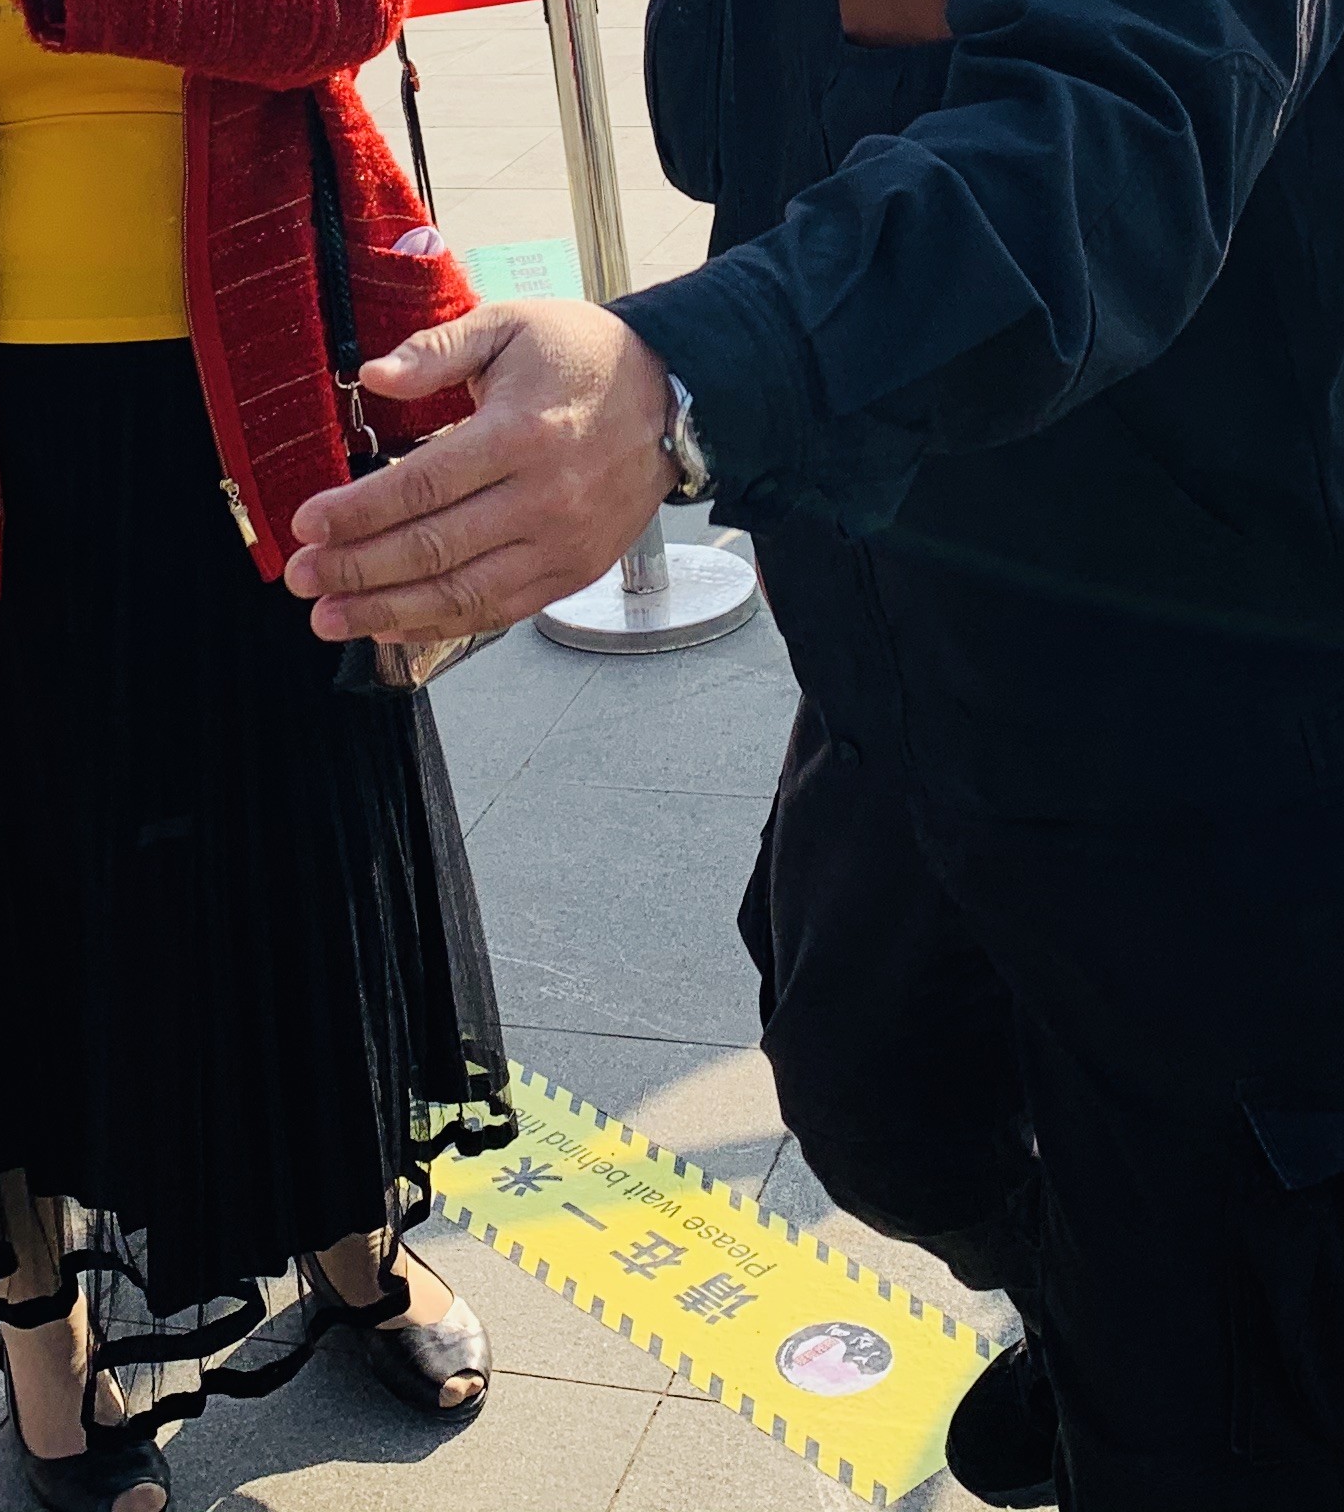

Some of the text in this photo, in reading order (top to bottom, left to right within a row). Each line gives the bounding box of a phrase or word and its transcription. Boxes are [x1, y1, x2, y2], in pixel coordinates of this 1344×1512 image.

[542, 1131, 631, 1188] behind
[624, 1179, 682, 1218] wait
[683, 1216, 778, 1279] Please
